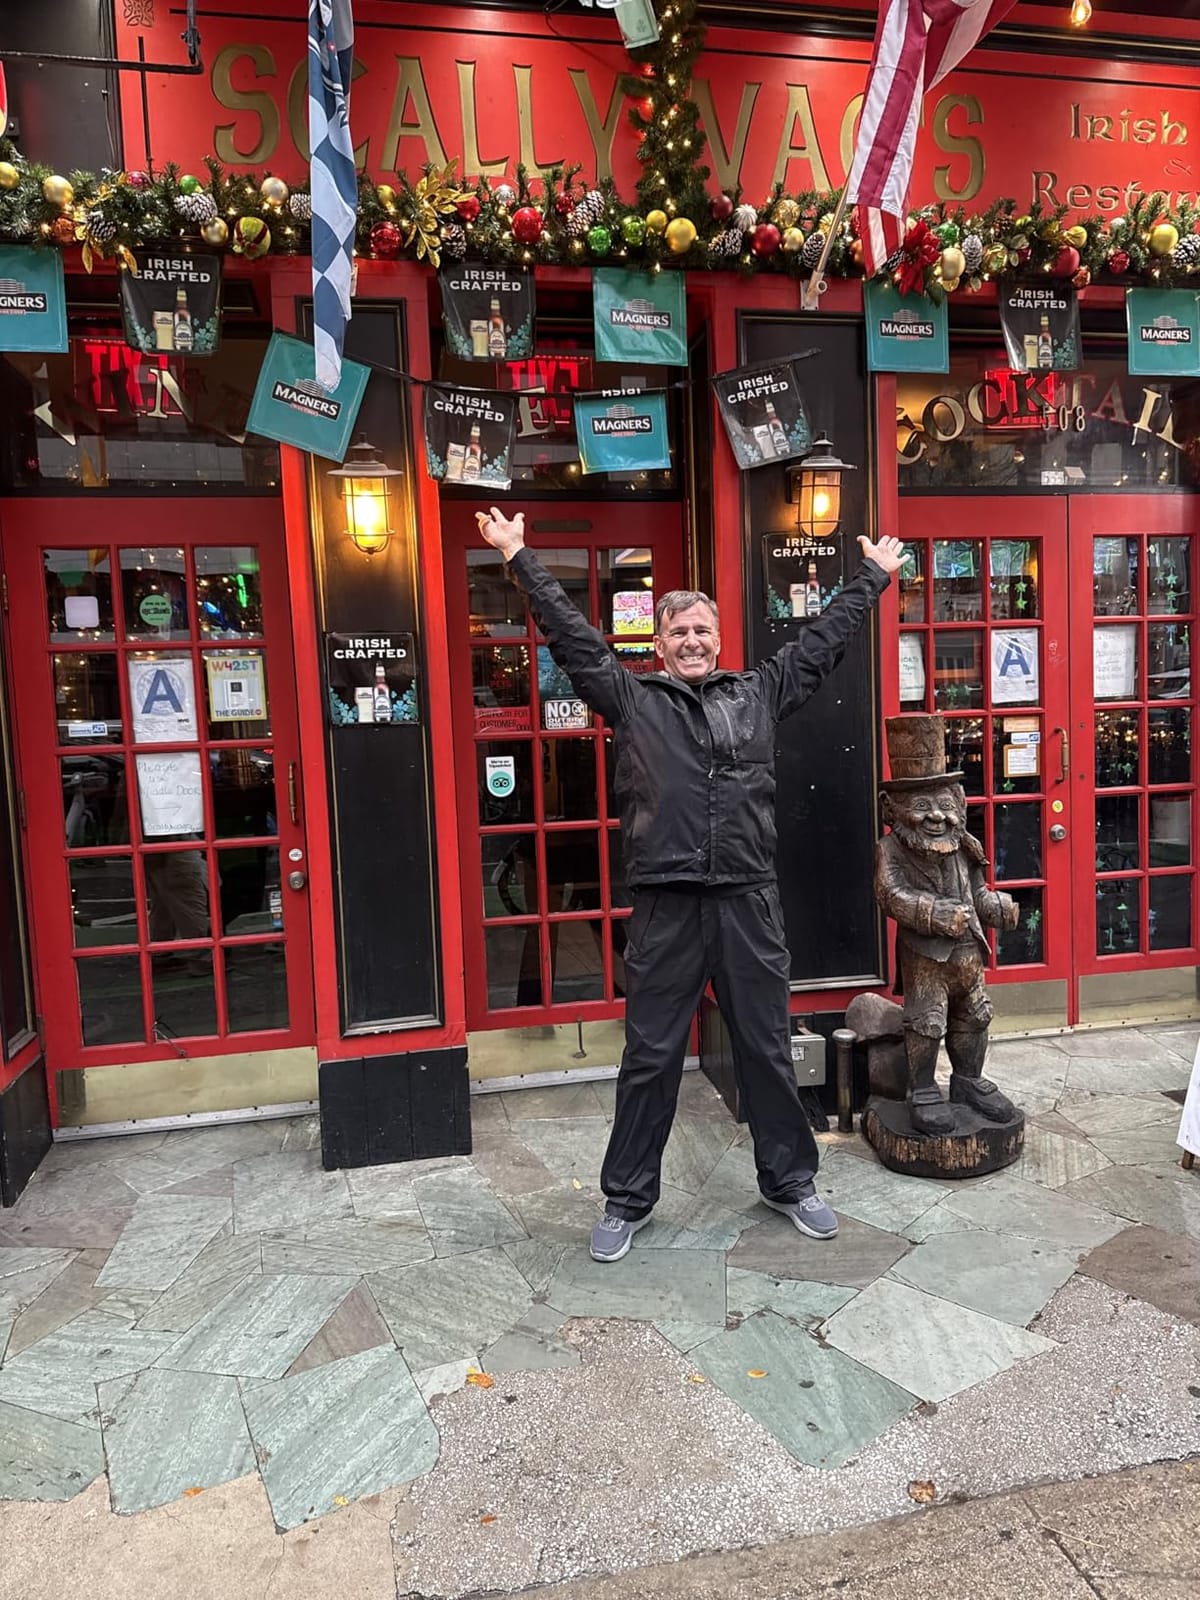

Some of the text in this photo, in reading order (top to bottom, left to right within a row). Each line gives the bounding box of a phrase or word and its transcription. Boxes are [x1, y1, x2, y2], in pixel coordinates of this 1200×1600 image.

[1070, 102, 1190, 145] Irish
[1162, 157, 1193, 177] &
[148, 258, 193, 271] IRISH
[134, 270, 211, 283] CRAFTED
[464, 270, 506, 281] IRISH
[449, 280, 522, 291] CRAFTED
[1019, 289, 1055, 299] IRISH
[1008, 298, 1067, 309] CRAFTED
[612, 311, 670, 326] MAGNERS
[880, 322, 933, 335] MAGNERS
[1141, 328, 1190, 341] MAGNERS
[738, 374, 774, 390] IRISH
[727, 380, 789, 404] CRAFTED
[274, 384, 338, 416] MAGNERS
[449, 393, 491, 409] IRISH
[433, 400, 505, 422] CRAFTED
[593, 418, 650, 432] MAGNERS
[785, 537, 823, 547] IRIS
[772, 546, 836, 558] CRAFTED
[348, 638, 391, 649] IRISH
[333, 648, 407, 659] CRAFTED
[999, 637, 1032, 677] A
[141, 669, 184, 714] A
[215, 709, 230, 717] THE
[547, 702, 571, 718] NO
